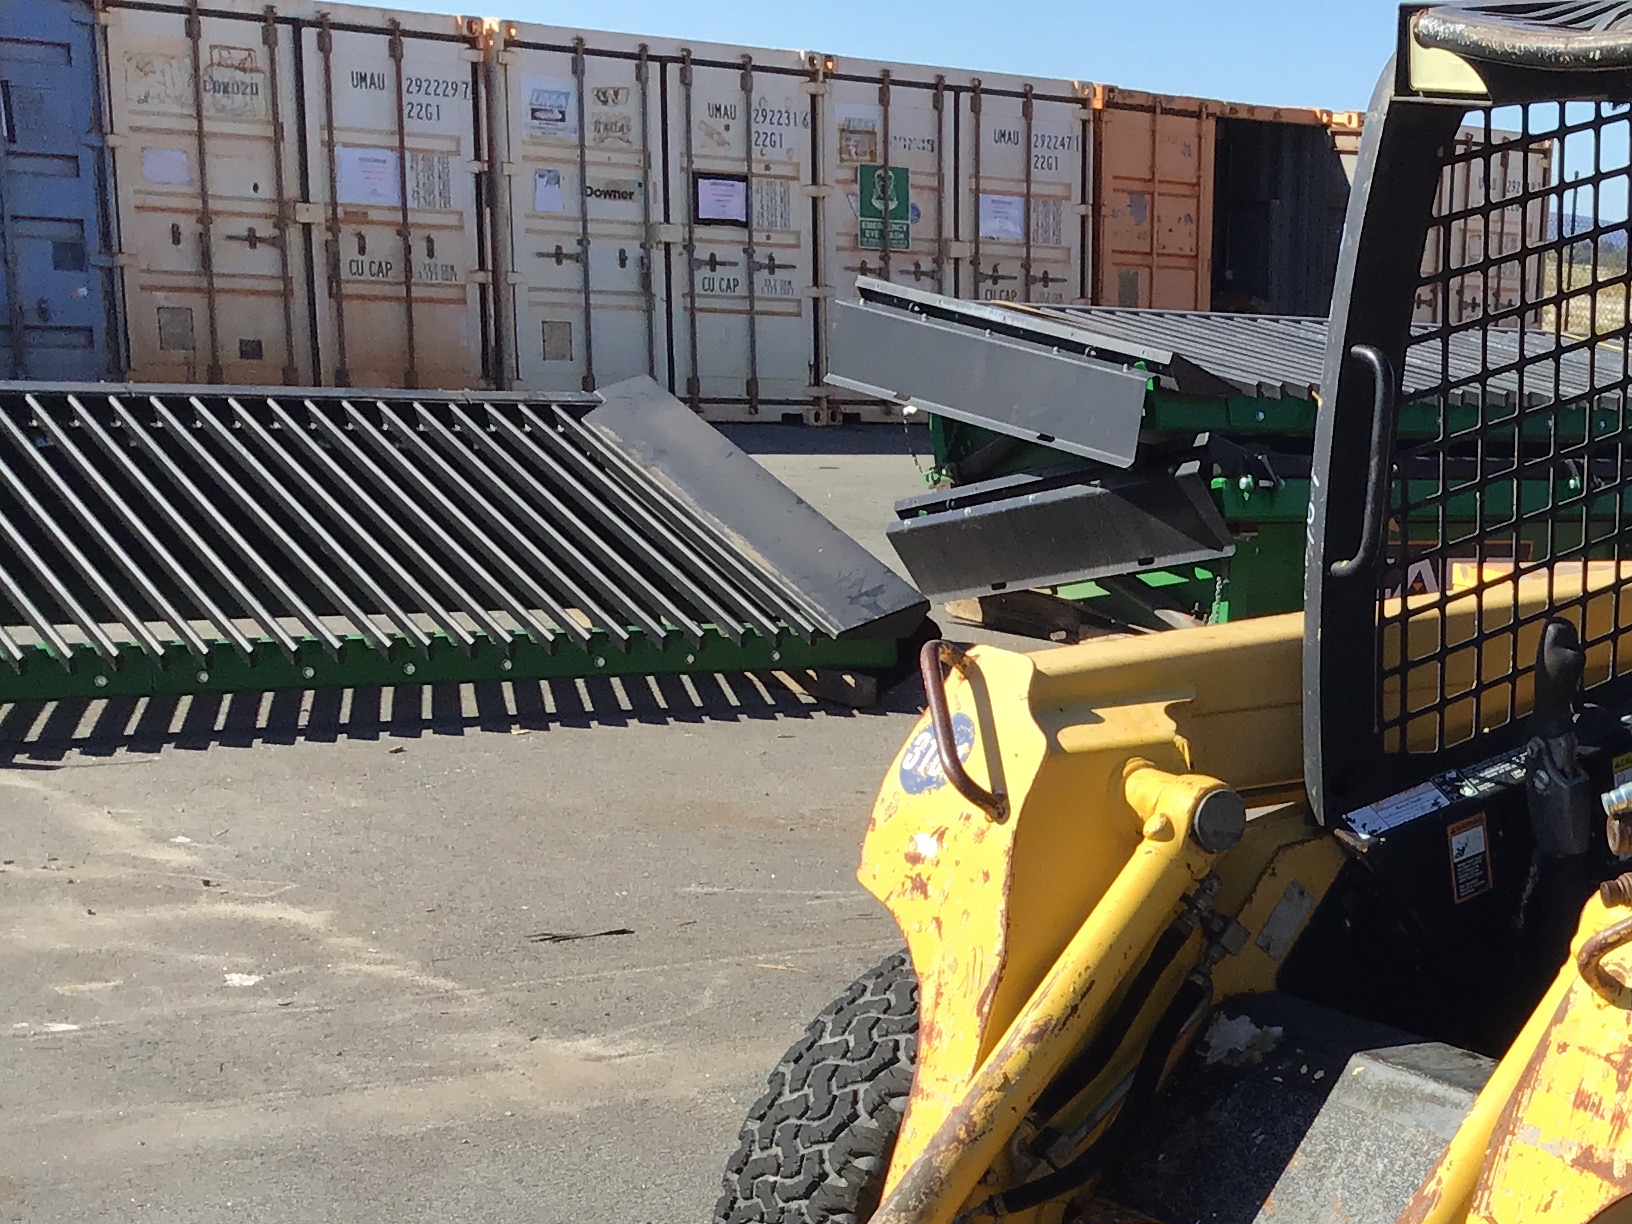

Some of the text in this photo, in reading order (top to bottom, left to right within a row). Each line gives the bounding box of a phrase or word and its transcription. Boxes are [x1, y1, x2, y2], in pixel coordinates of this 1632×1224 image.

[351, 70, 385, 91] UMAU
[406, 102, 440, 121] 22G1
[708, 101, 737, 121] UMAU
[754, 130, 783, 149] 22G1
[993, 128, 1020, 146] UMAU
[1033, 154, 1059, 171] 22G1
[584, 185, 635, 200] Downer
[349, 259, 393, 278] CU CAP
[719, 277, 740, 294] CAP
